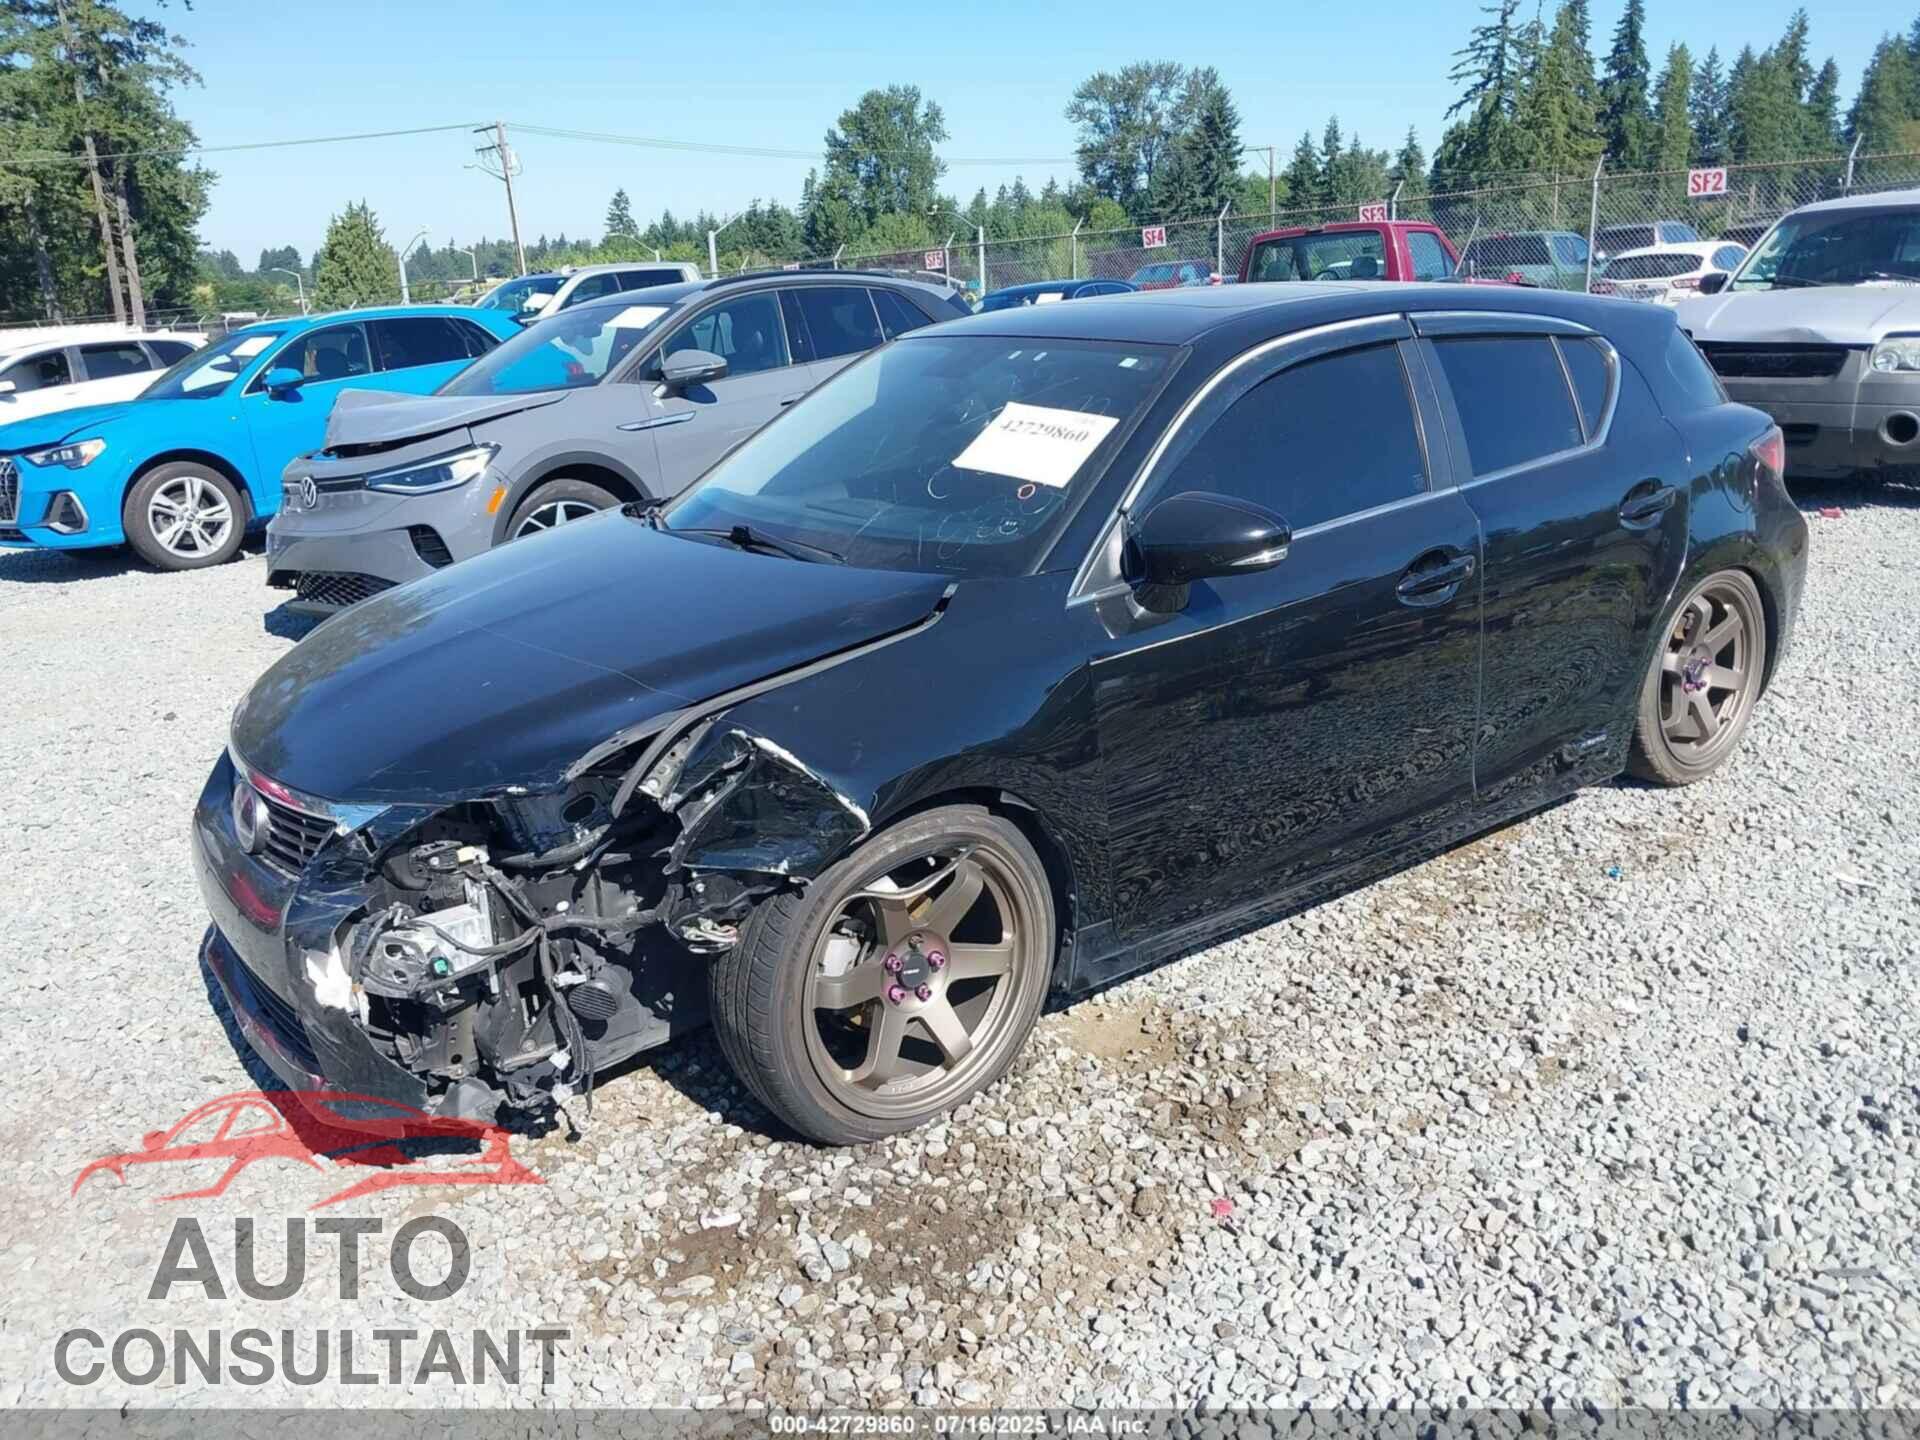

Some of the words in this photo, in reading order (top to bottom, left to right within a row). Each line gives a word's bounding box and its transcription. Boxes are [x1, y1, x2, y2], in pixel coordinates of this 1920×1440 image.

[1691, 171, 1723, 193] SF2
[1361, 206, 1385, 222] SF3
[1144, 229, 1164, 246] SF4
[1000, 419, 1089, 442] 42729860
